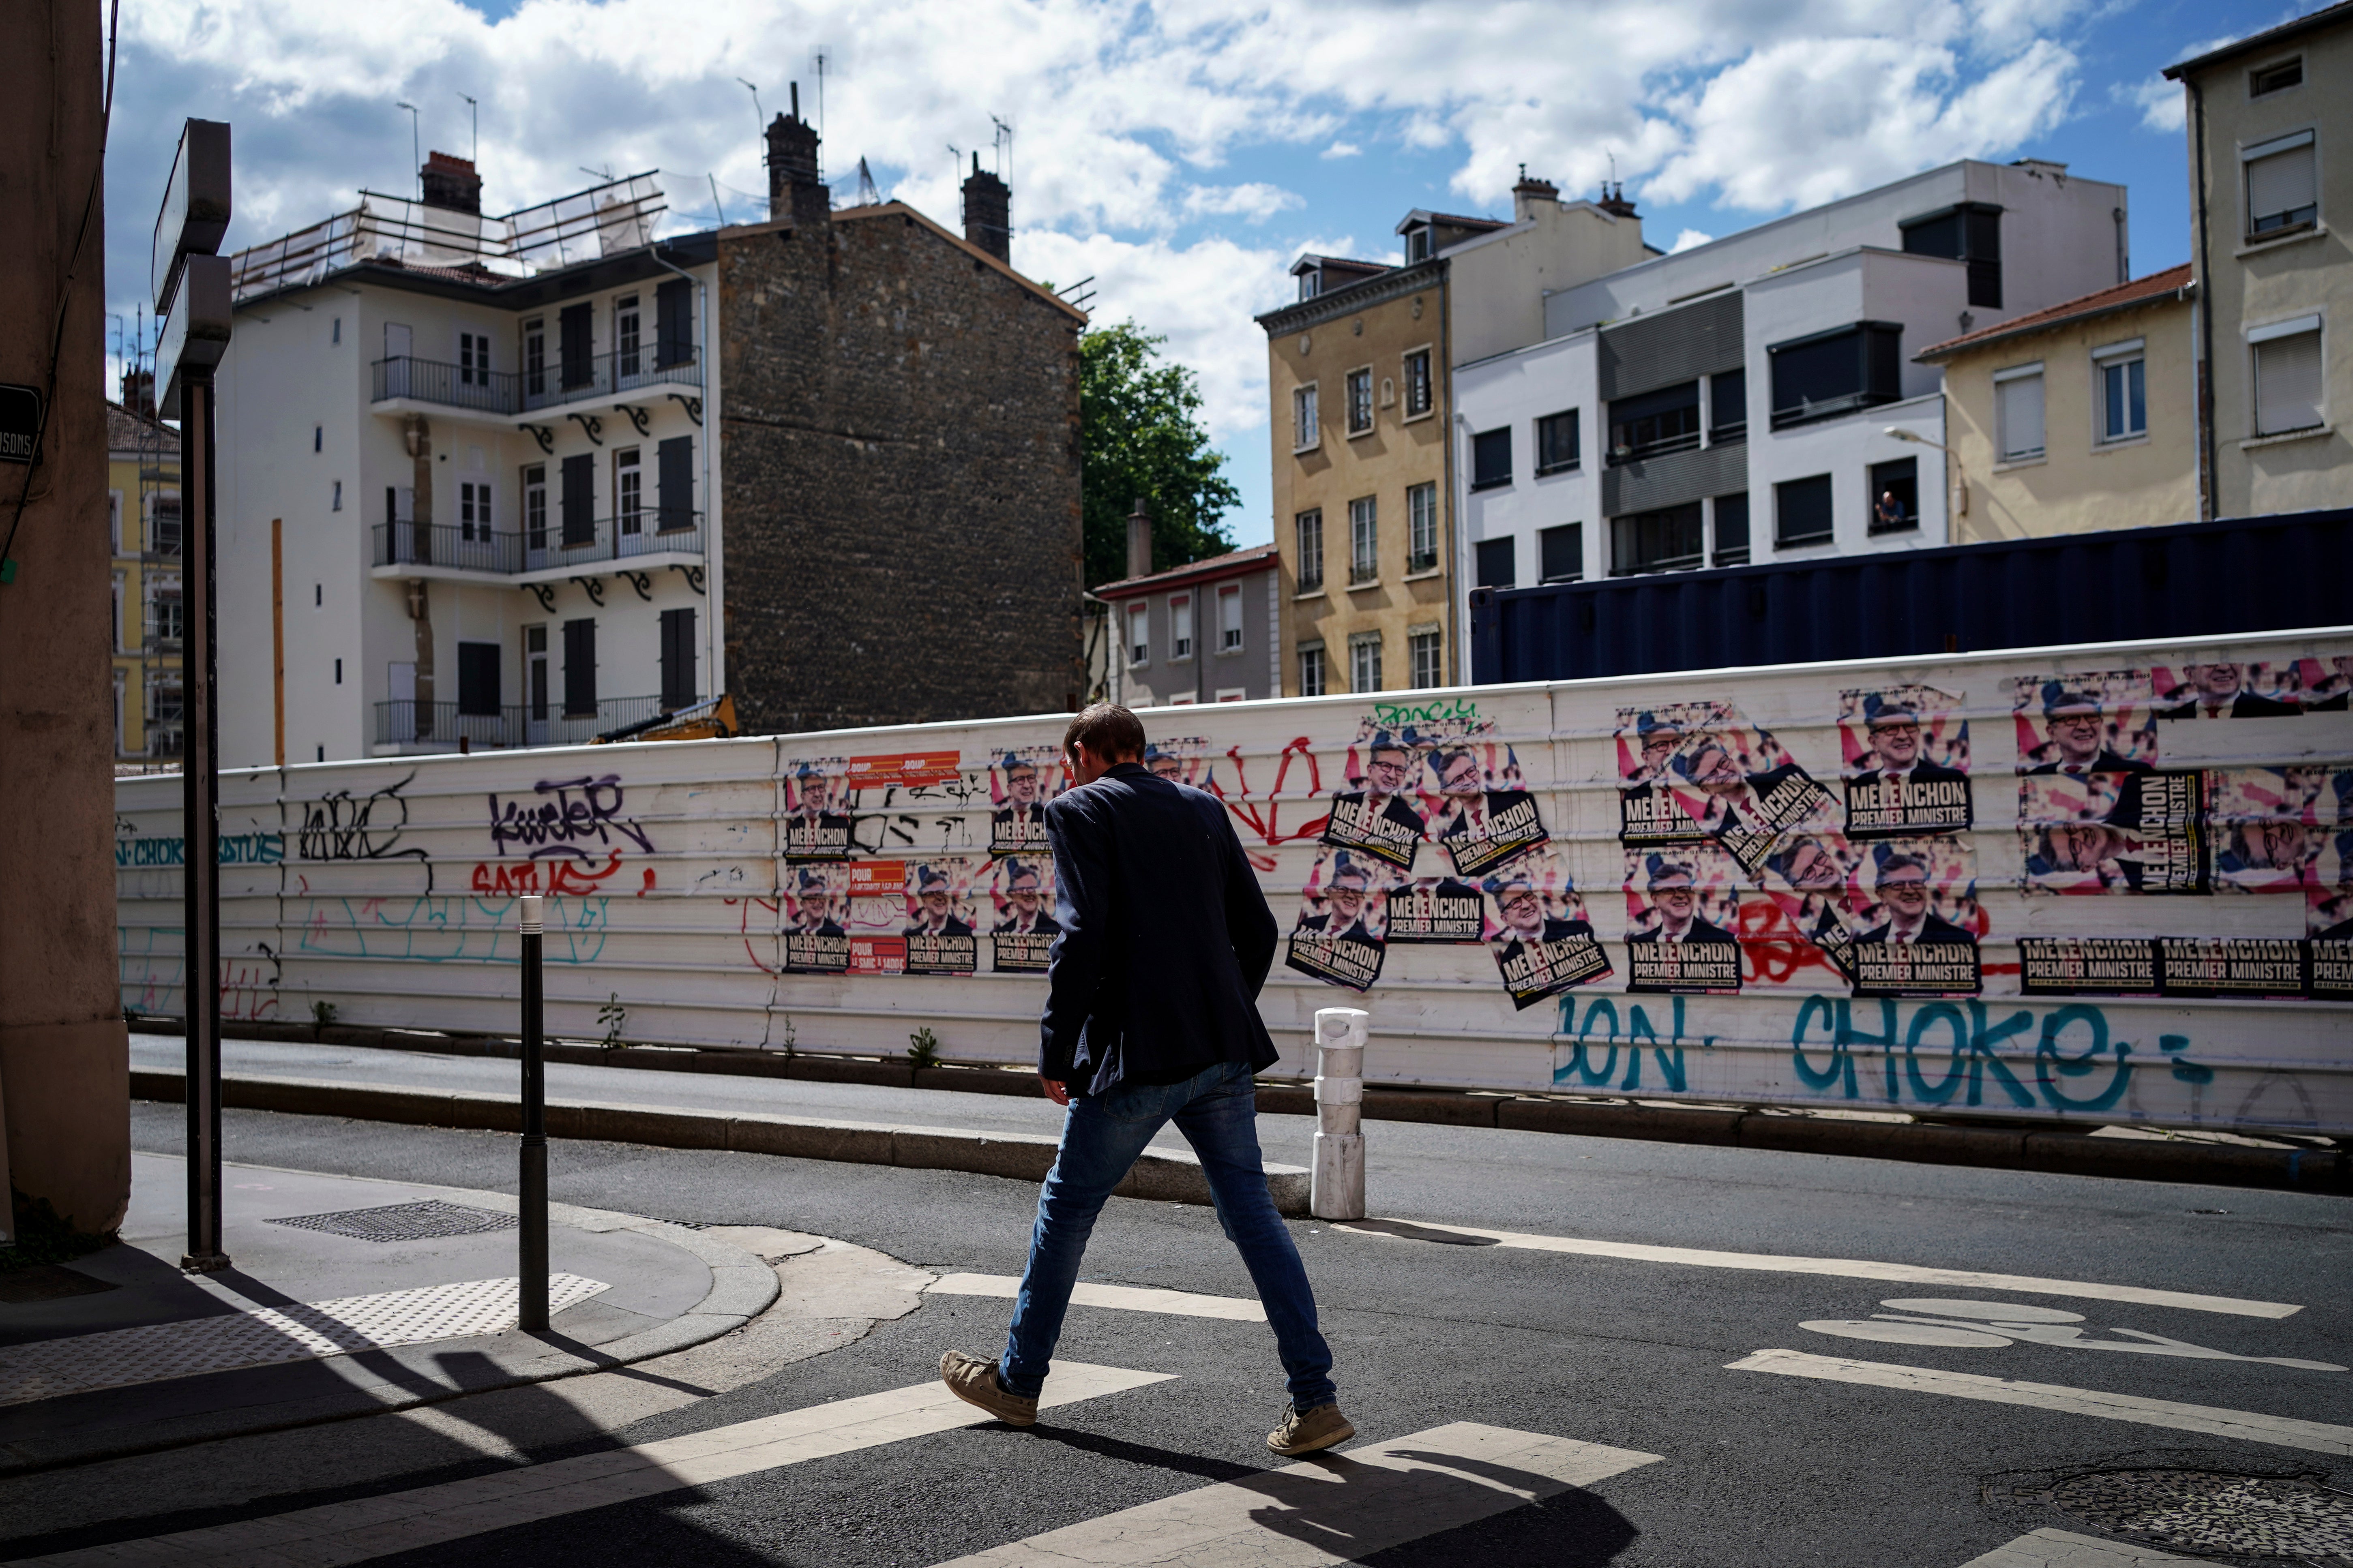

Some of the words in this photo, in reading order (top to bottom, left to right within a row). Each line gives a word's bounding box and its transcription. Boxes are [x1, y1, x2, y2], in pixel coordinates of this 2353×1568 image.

[1626, 797, 1690, 821] MÉLEN
[1852, 810, 1904, 825] PREMIER
[1908, 806, 1967, 824] MINISTRE
[995, 821, 1047, 841] MÉLENCH
[1455, 839, 1498, 867] PREMIER
[1493, 818, 1540, 846] MINISTRE
[852, 868, 872, 882] POUR
[1391, 919, 1432, 933] PREMIER
[1434, 920, 1480, 934] MINISTRE
[852, 942, 872, 956] POUR
[910, 951, 939, 963] PREMIER
[941, 952, 974, 964] MINISTRE
[997, 947, 1029, 960] PREMIER
[1030, 949, 1052, 962] MINIS
[790, 951, 816, 964] PREMIER
[817, 953, 847, 966] MINISTRE
[1293, 941, 1332, 966] PREMIER
[1332, 955, 1376, 982] MINISTRE
[1508, 967, 1555, 993] PREMIER
[1553, 946, 1602, 978] MINISTRE
[1634, 963, 1681, 978] PREMIER
[1683, 963, 1737, 979] MINISTRE
[1859, 964, 1912, 981] PREMIER
[1915, 964, 1975, 981] MINISTRE
[2027, 960, 2085, 978] PREMIER
[2088, 961, 2154, 978] MINISTRE
[2165, 960, 2226, 979] PREMIER
[2231, 962, 2301, 980] MINISTRE
[2314, 962, 2353, 981] PREM
